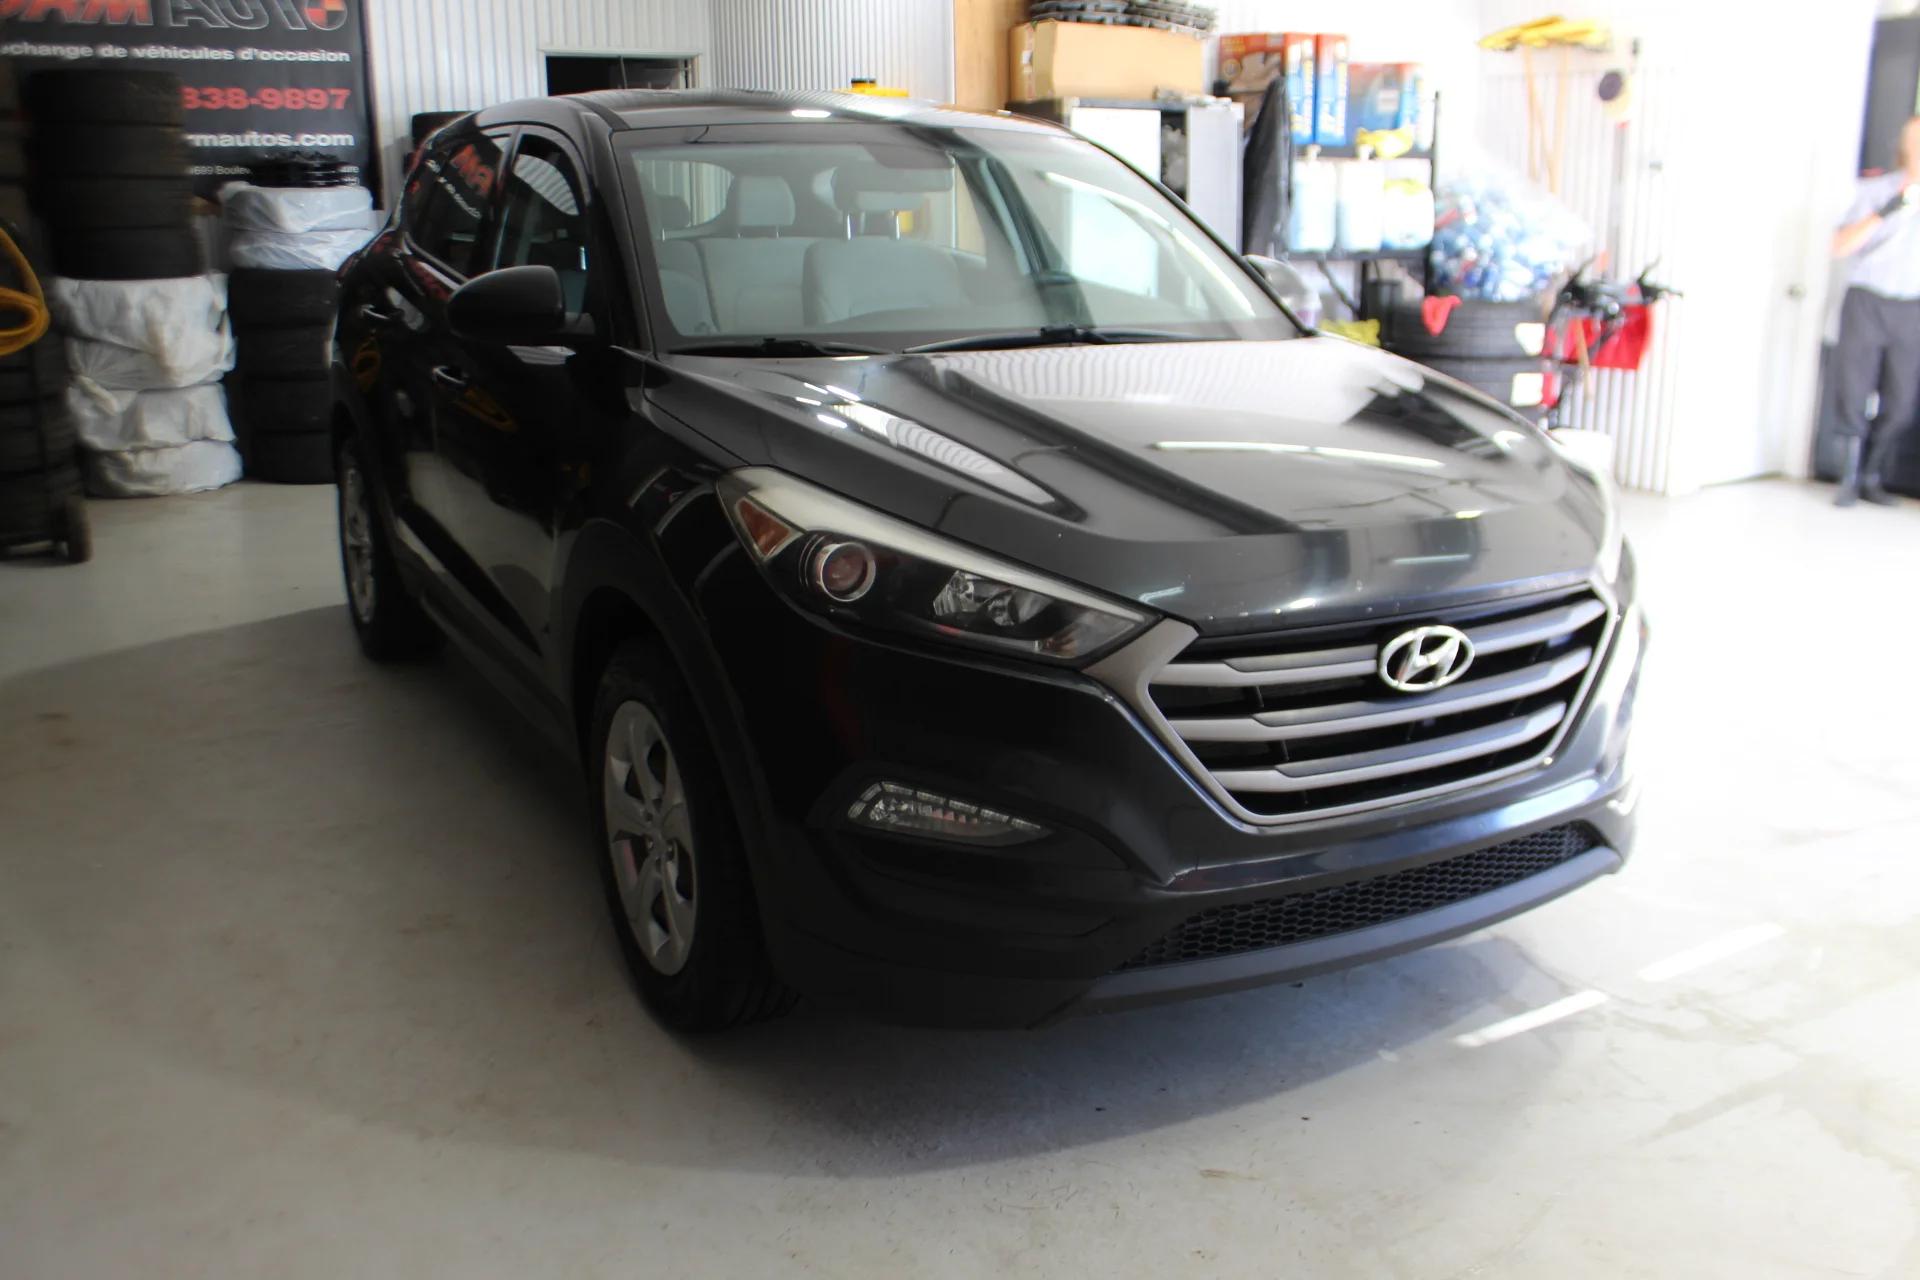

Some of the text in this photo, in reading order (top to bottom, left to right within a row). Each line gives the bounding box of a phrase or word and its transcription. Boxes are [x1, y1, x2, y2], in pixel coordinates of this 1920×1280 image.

[99, 44, 128, 58] de
[130, 46, 235, 61] véhicules
[239, 48, 350, 62] d'occasion
